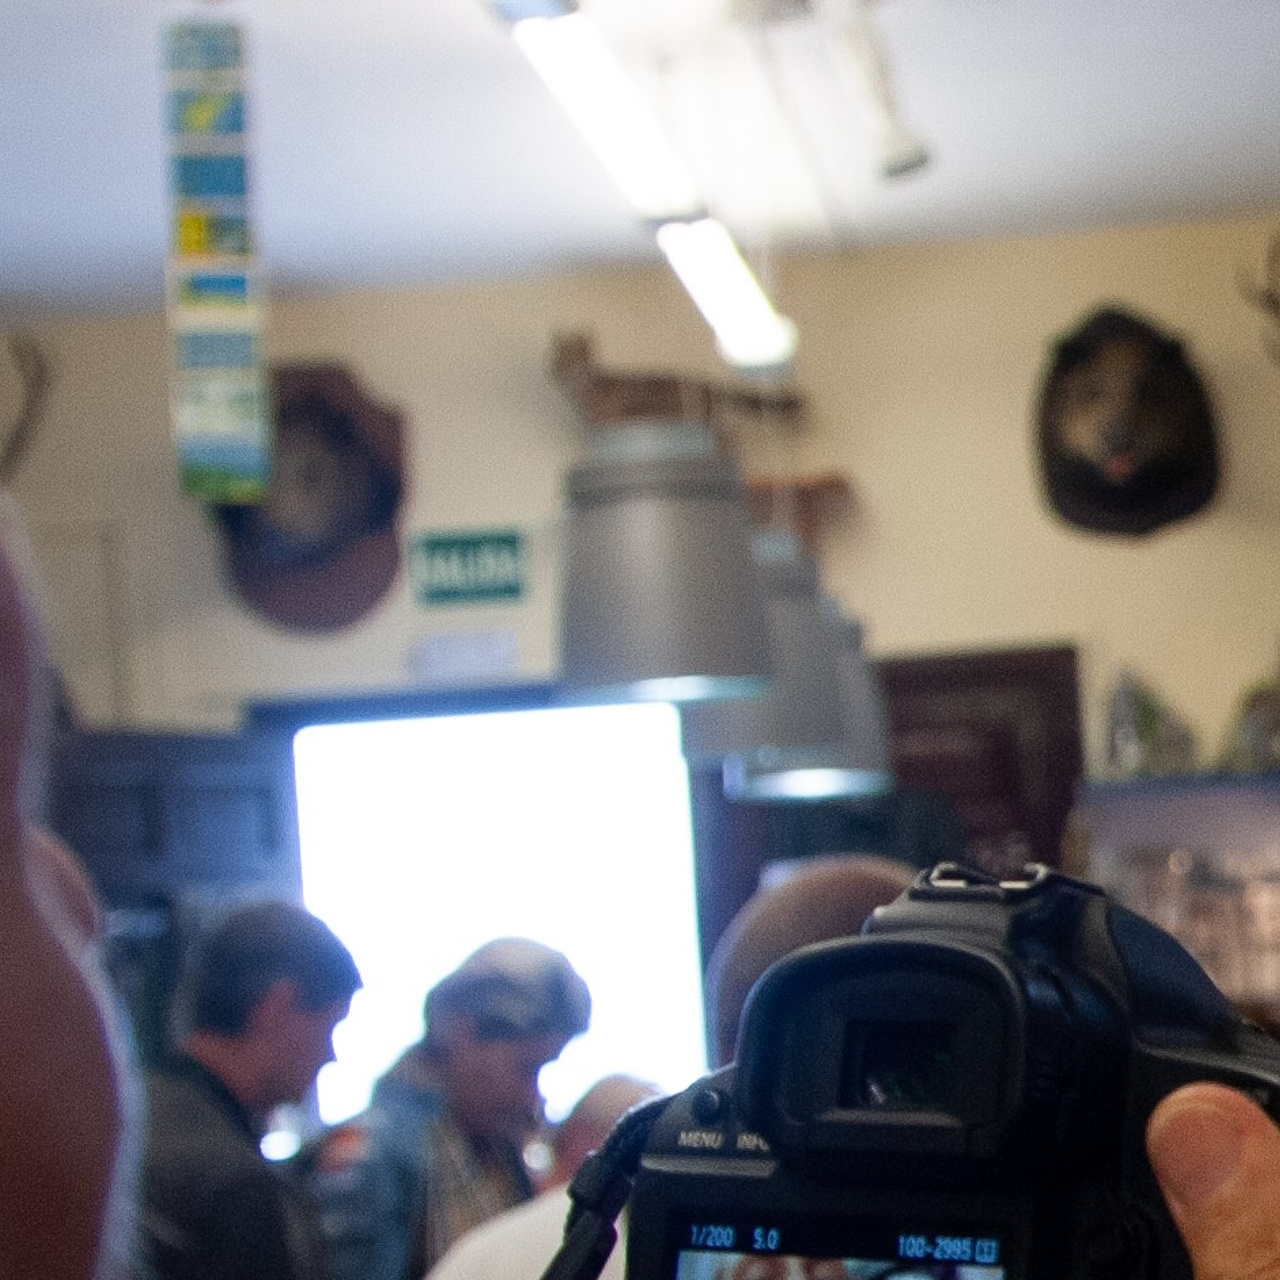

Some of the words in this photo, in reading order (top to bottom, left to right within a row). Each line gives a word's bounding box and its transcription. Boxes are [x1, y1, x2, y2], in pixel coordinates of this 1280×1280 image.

[677, 1130, 723, 1150] MENU
[690, 1224, 735, 1249] 1/200
[753, 1227, 780, 1251] 5.0
